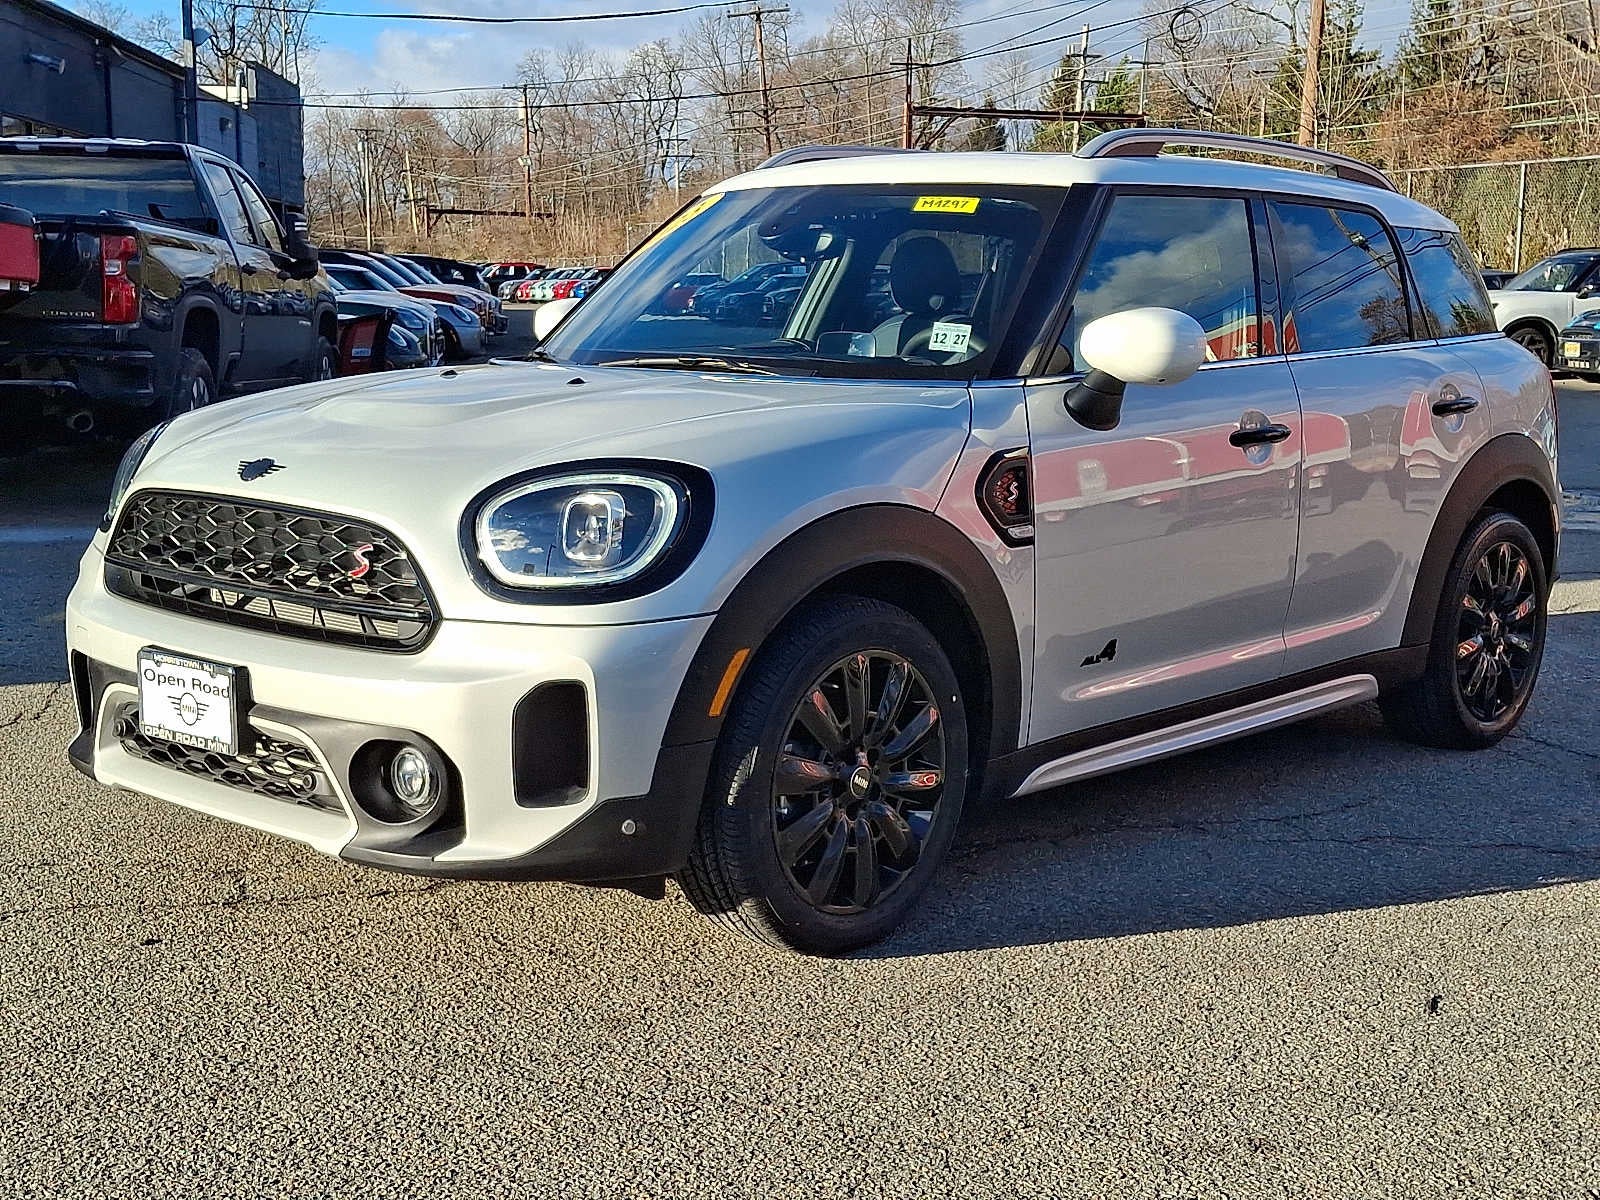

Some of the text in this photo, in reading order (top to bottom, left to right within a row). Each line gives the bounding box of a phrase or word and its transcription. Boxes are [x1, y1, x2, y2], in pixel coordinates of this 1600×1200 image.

[933, 332, 968, 346] 12 27
[1007, 481, 1019, 501] S
[347, 543, 374, 579] S
[143, 668, 230, 699] Open Road
[144, 725, 231, 755] OPEN ROAD MINI
